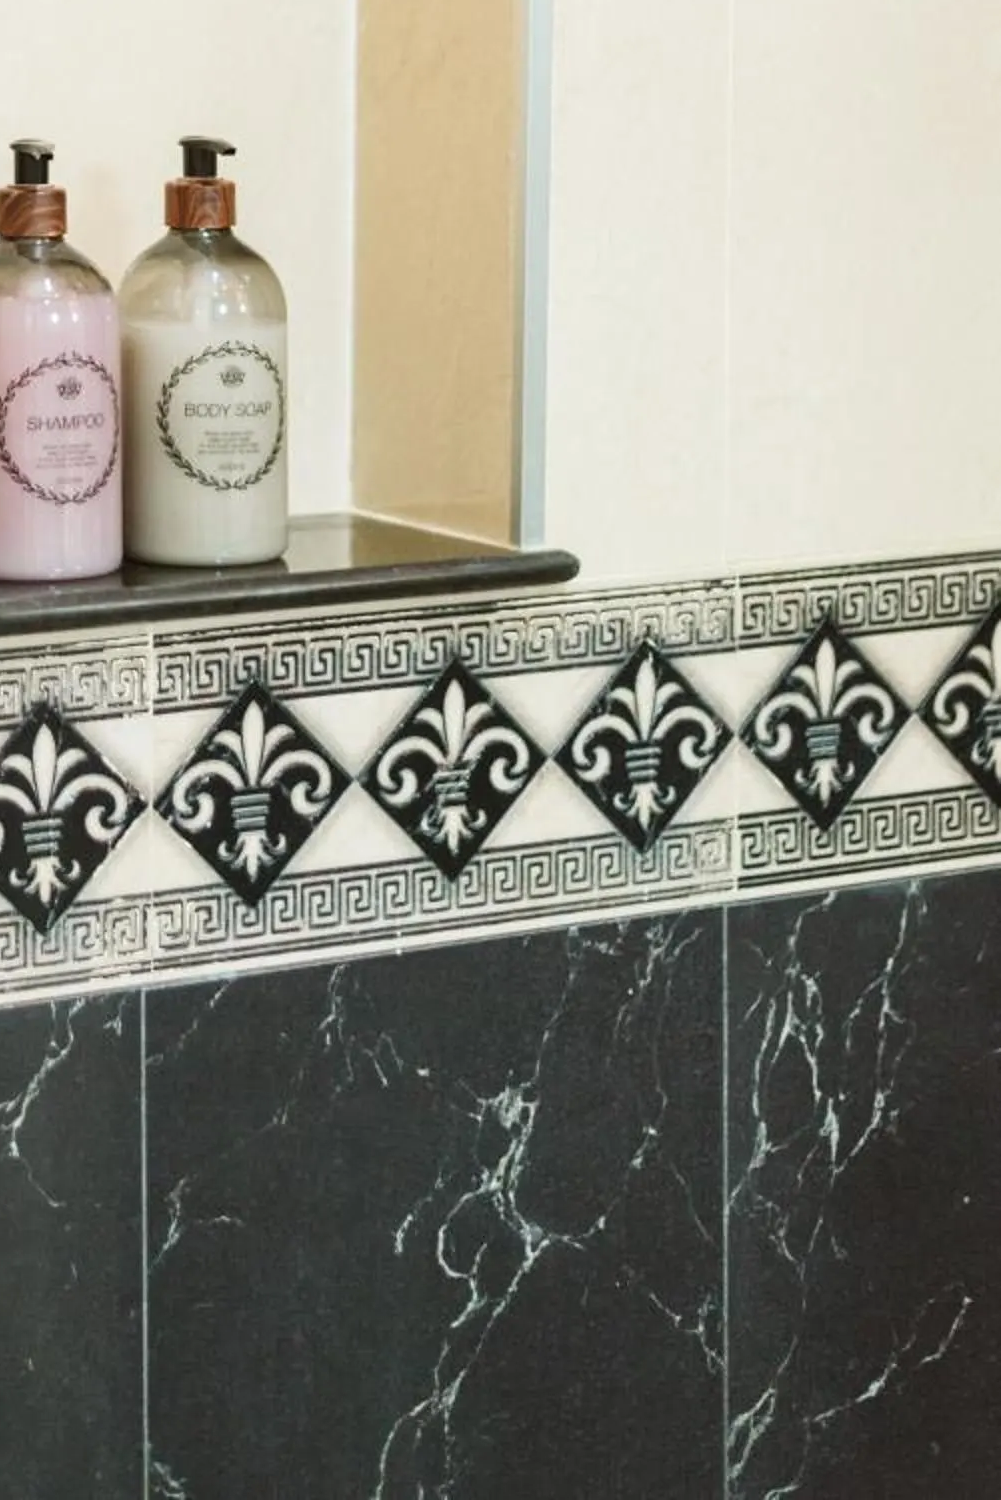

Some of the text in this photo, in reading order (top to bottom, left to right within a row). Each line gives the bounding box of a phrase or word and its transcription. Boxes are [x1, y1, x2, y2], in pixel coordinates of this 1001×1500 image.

[184, 401, 272, 418] BODY SOAP
[27, 412, 105, 431] SHAMPOO
